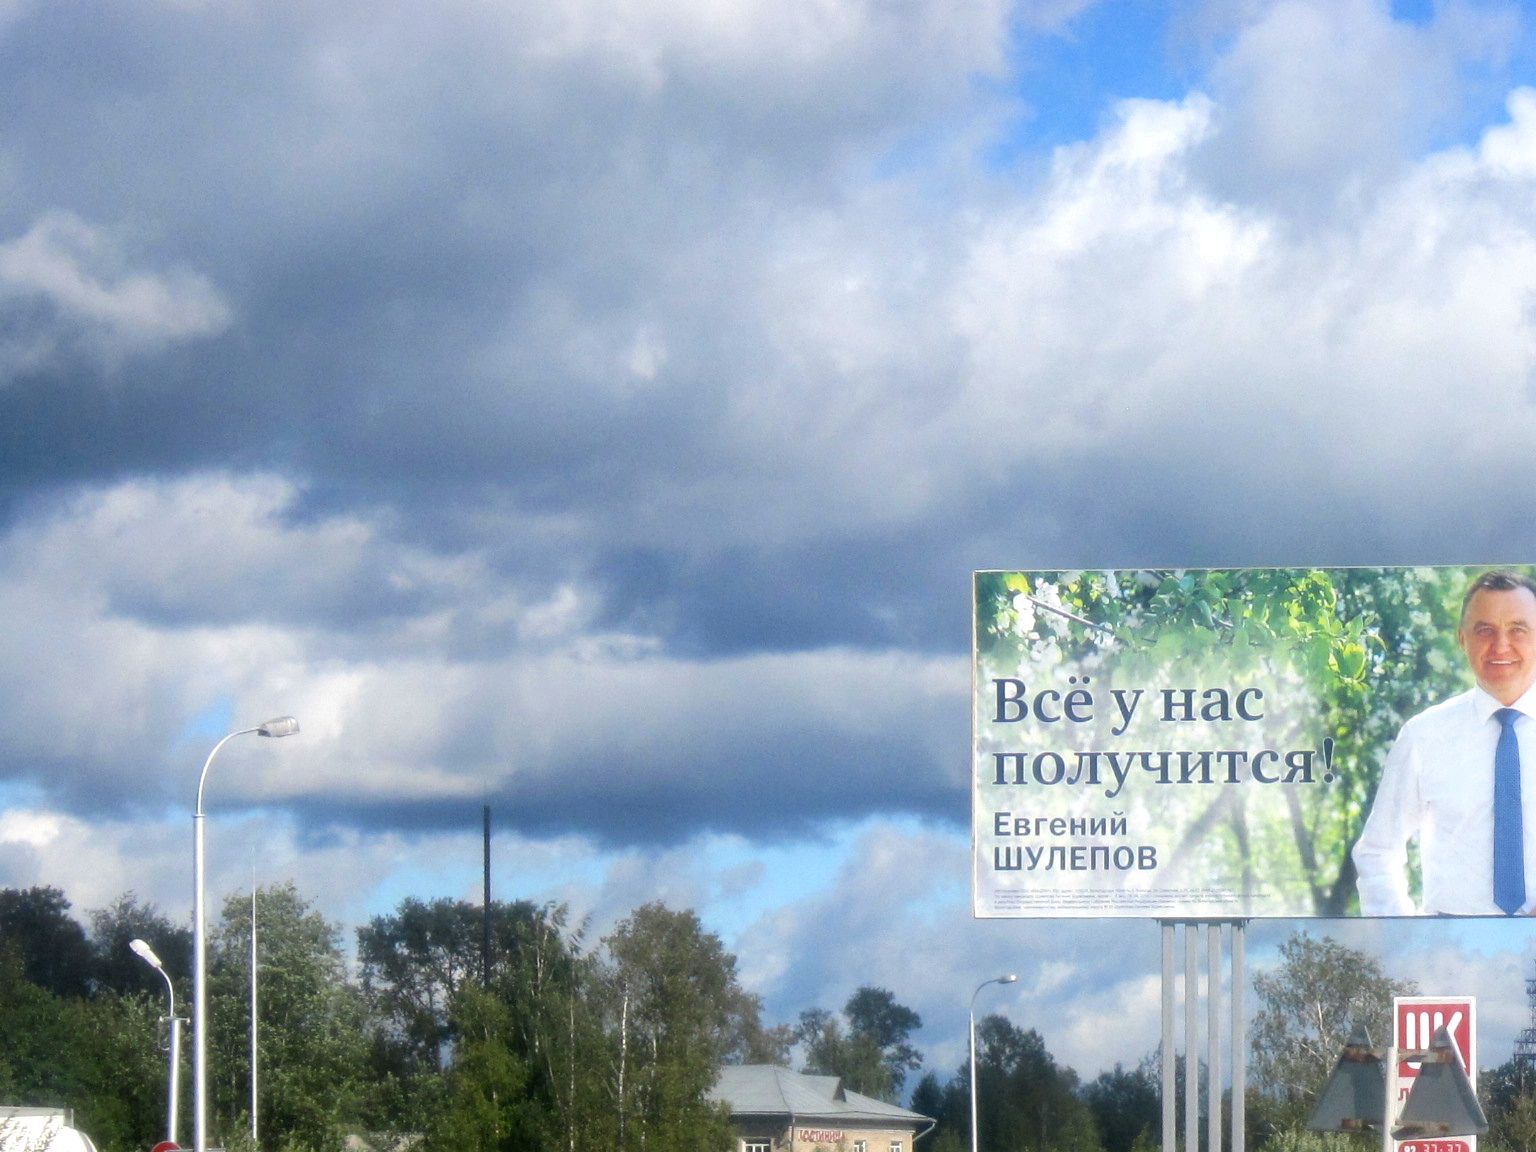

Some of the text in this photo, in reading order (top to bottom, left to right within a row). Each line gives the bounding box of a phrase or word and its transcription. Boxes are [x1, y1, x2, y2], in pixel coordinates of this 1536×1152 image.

[992, 676, 1265, 736] Всё у нас
[992, 736, 1336, 799] получится!
[993, 811, 1128, 837] Евгений
[993, 845, 1158, 871] ШУЛЕПОВ
